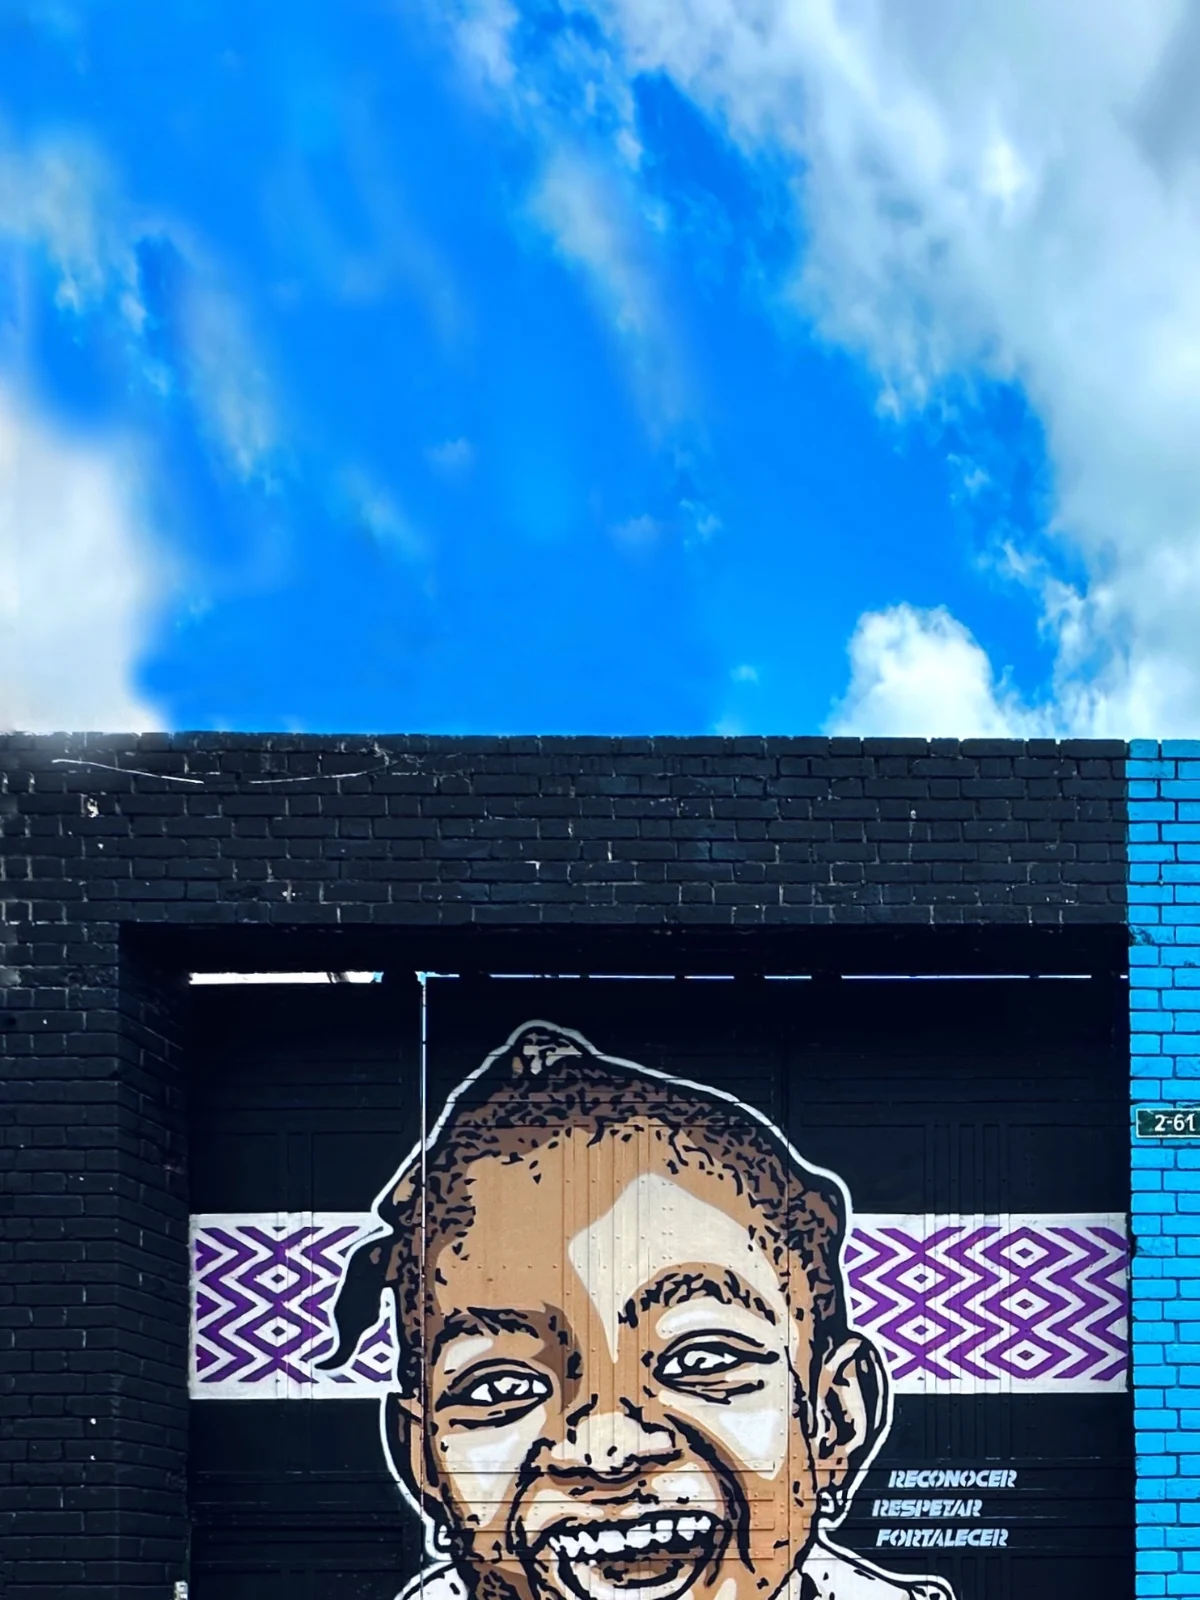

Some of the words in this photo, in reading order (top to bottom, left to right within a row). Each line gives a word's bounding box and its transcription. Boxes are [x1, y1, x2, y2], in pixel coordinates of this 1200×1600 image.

[1154, 1113, 1196, 1132] 2-61
[888, 1469, 1018, 1488] RECONOCER
[872, 1499, 983, 1517] RESPETAR
[876, 1528, 1009, 1548] FORTALECER
